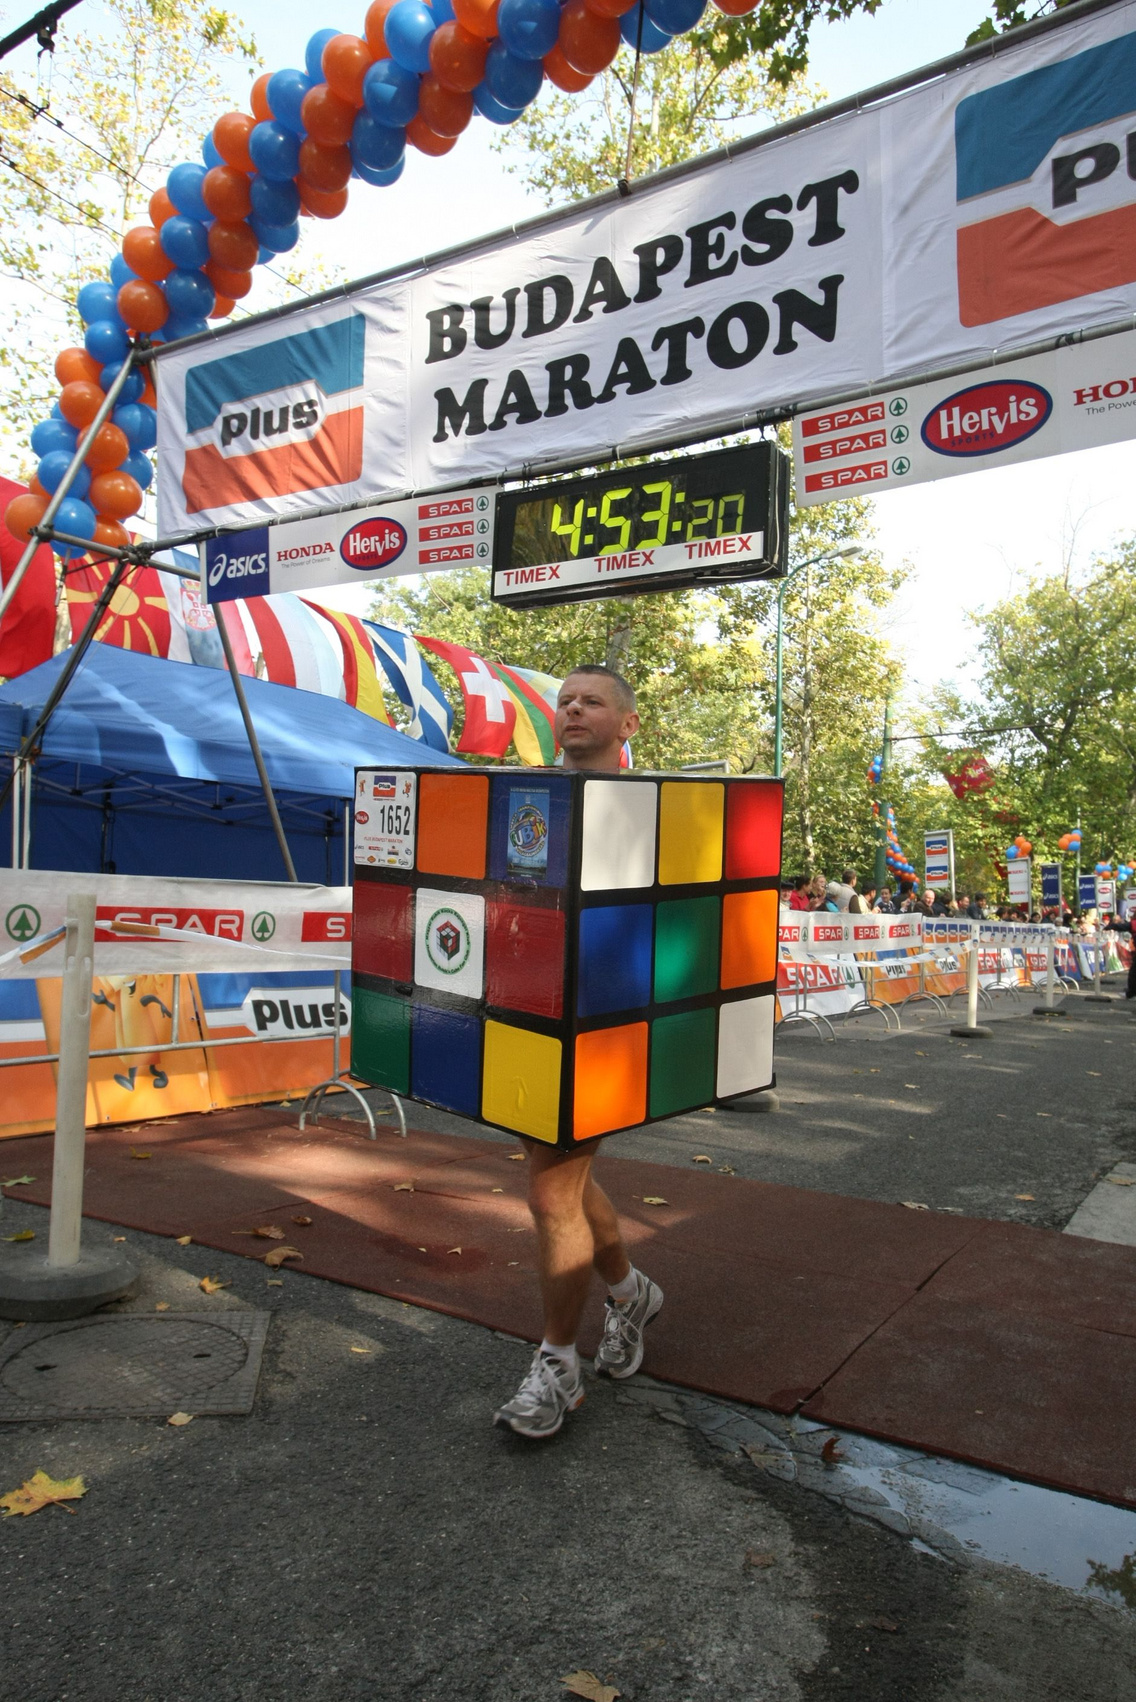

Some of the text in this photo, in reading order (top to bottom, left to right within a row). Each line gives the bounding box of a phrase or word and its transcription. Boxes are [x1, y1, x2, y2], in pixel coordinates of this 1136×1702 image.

[425, 169, 859, 364] BUDAPEST
[432, 274, 845, 443] MARATON
[818, 406, 883, 432] SPAR
[939, 395, 1039, 440] Hervis
[1085, 406, 1105, 416] The
[820, 433, 885, 458] SPAR
[951, 431, 995, 447] SPORTS
[821, 464, 887, 488] SPAR
[428, 501, 473, 517] SPAR
[349, 528, 400, 556] Hervis
[429, 524, 473, 539] SPAR
[276, 541, 335, 562] HONDA
[429, 547, 473, 562] SPAR
[503, 535, 752, 586] TIMEX TIMEX TIMEX
[380, 804, 411, 836] 1652
[818, 928, 842, 940] SPAR
[859, 927, 879, 939] SPAR
[892, 926, 910, 937] SPAR
[252, 1000, 349, 1032] Plus
